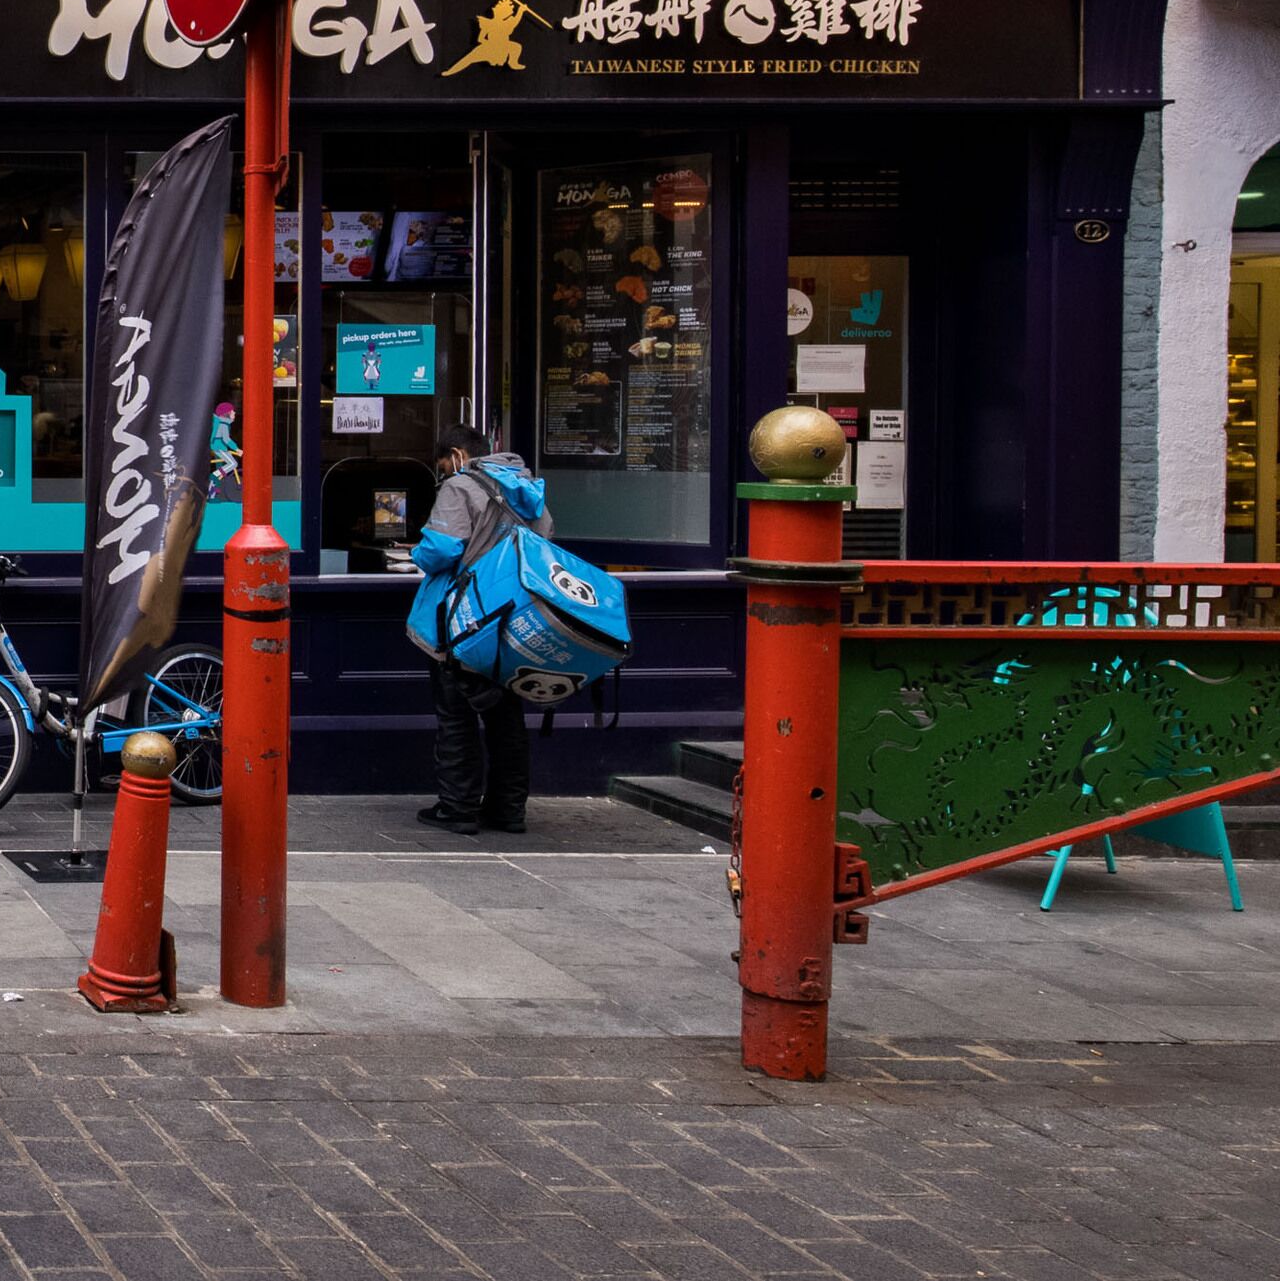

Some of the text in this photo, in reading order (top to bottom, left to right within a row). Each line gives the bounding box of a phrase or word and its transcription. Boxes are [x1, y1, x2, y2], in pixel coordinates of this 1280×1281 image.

[571, 58, 921, 75] TAIWANESE STYLE FRIED CHICKEN
[1083, 224, 1103, 238] 12
[342, 329, 417, 345] pickup orders here
[841, 327, 893, 339] deliveroo
